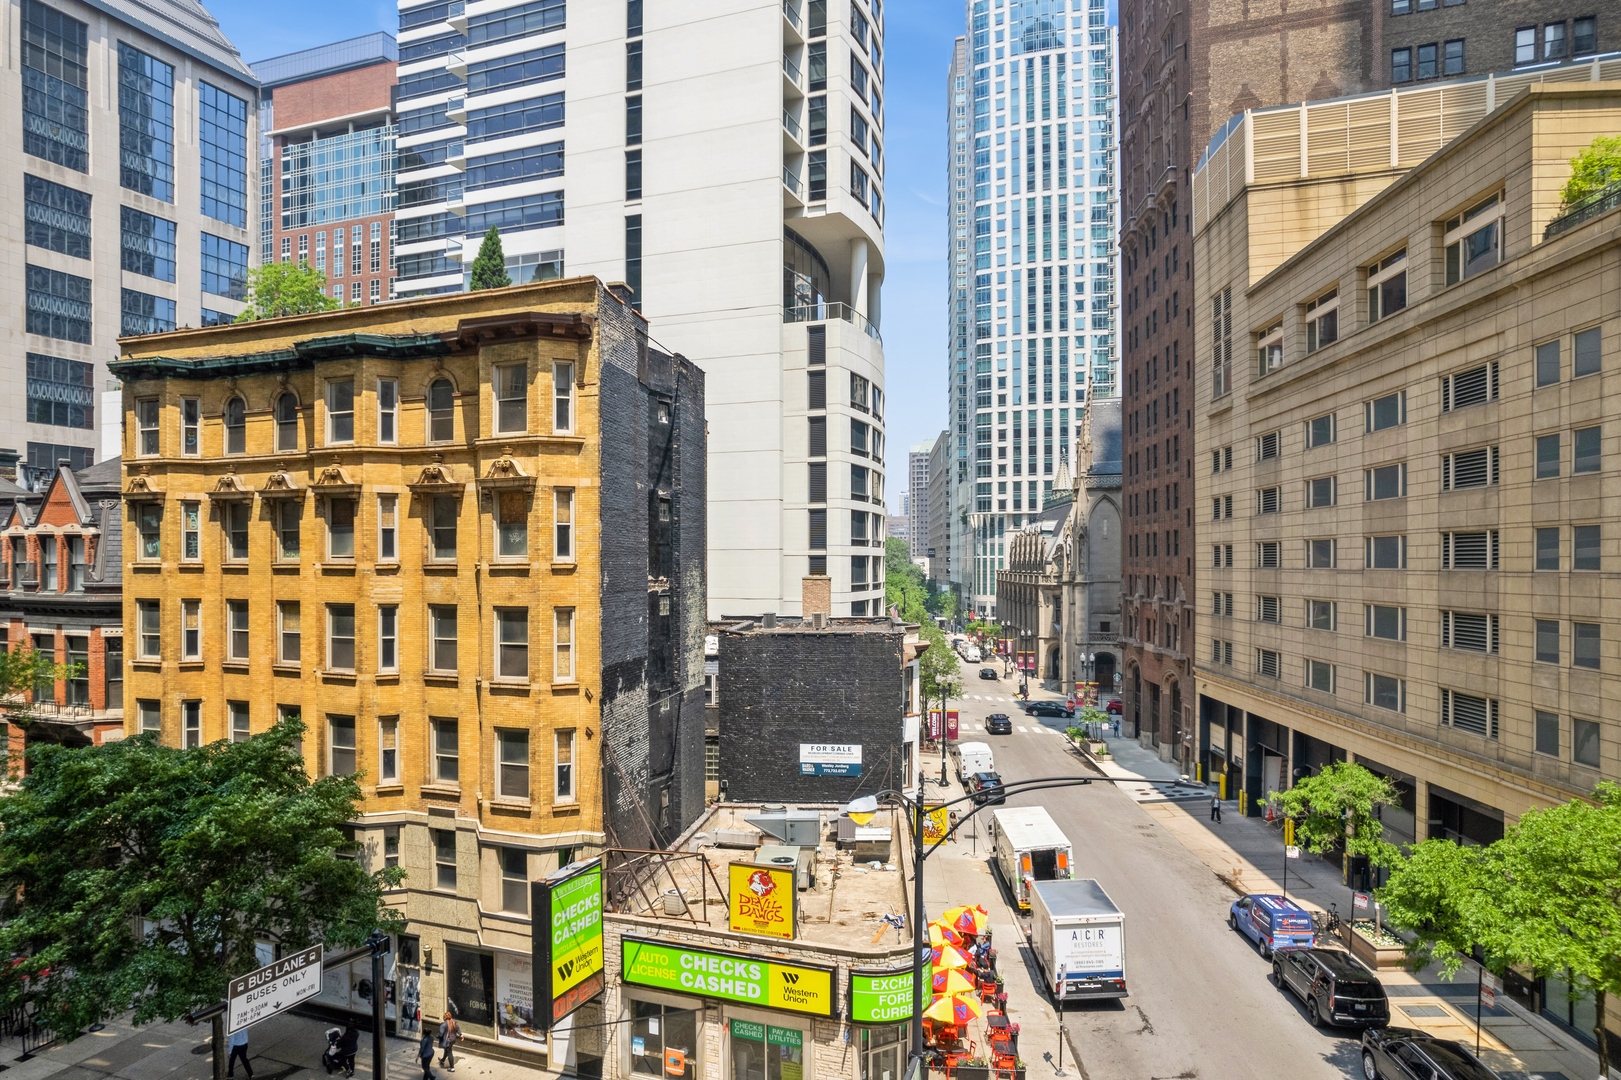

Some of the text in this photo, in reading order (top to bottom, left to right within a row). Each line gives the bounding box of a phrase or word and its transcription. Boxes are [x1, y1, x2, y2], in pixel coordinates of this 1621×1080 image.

[554, 892, 599, 927] CHECKS
[739, 893, 782, 911] DEVIL
[739, 904, 784, 922] DAWGS
[554, 910, 599, 945] CASHED
[575, 946, 599, 964] Western
[639, 951, 669, 966] AUTO
[248, 955, 306, 989] BUS LANE
[575, 958, 593, 973] Union
[631, 964, 677, 981] LICENSE
[680, 953, 761, 980] CHECKS
[680, 972, 761, 999] CASHED
[871, 966, 929, 990] EXCHAGE
[246, 970, 307, 1004] BUSES ONLY
[296, 983, 315, 997] MON-FRI
[509, 983, 533, 991] RESIDENTIA
[509, 988, 533, 997] HOSPITALIT
[783, 986, 818, 999] Western
[879, 983, 926, 1006] FOREN
[510, 994, 533, 1002] RESTAURAN
[554, 975, 600, 1018] OPEN
[783, 993, 808, 1005] Union
[871, 994, 929, 1019] CURRECY
[236, 1011, 261, 1026] 4PM-6PM
[734, 1021, 763, 1033] CHECKS
[734, 1028, 763, 1038] CASHED
[768, 1034, 802, 1046] UTILITIES
